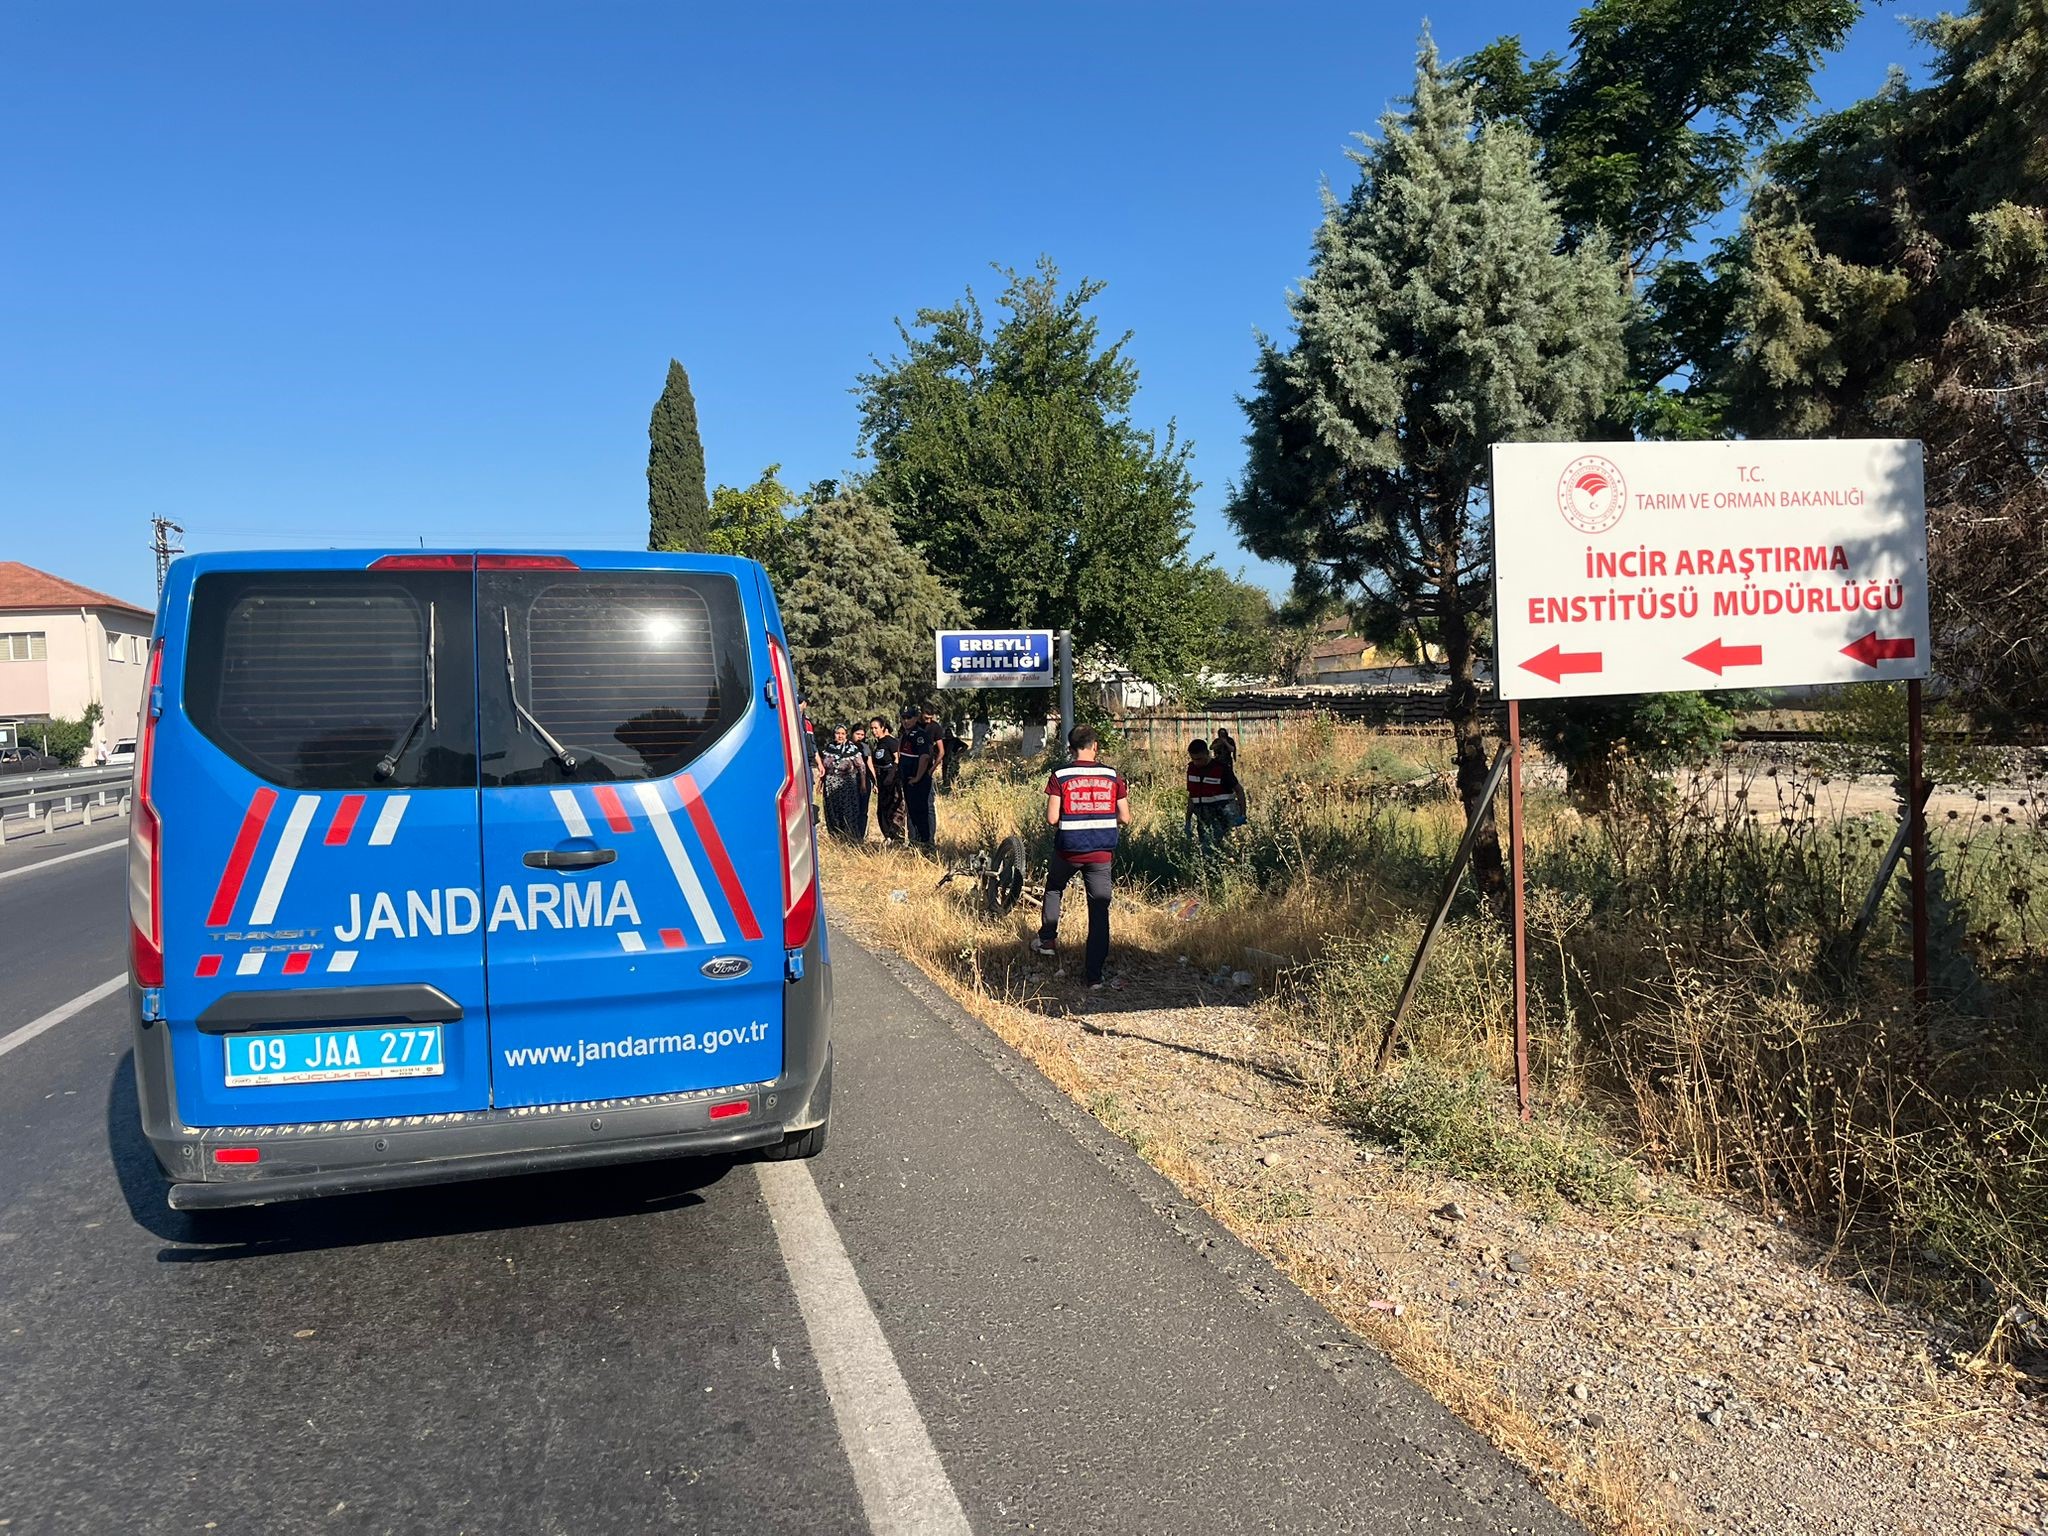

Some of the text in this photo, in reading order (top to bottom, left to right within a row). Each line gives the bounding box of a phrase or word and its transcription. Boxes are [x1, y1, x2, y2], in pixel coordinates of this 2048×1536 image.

[1737, 466, 1765, 483] T.C.
[1635, 487, 1864, 511] TARIM VE ORMAN BAKANLIĞI
[1586, 544, 1849, 580] İNCİR ARAŞTIRMA
[1528, 578, 1904, 624] ENSTİTÜSÜ MÜDÜRLÜĞÜ
[959, 635, 1031, 651] ERBEYLİ
[951, 653, 1040, 672] ŞEHİTLİĞİ
[1067, 778, 1113, 791] JANDARMA
[1070, 791, 1091, 801] OLAY
[334, 880, 642, 943] JANDARMA
[208, 928, 321, 941] TRANSIT
[249, 943, 325, 953] CUSTOM
[712, 959, 741, 975] Ford
[248, 1030, 436, 1072] 09 JAA 277
[504, 1020, 769, 1067] www.jandarma.gov.tr
